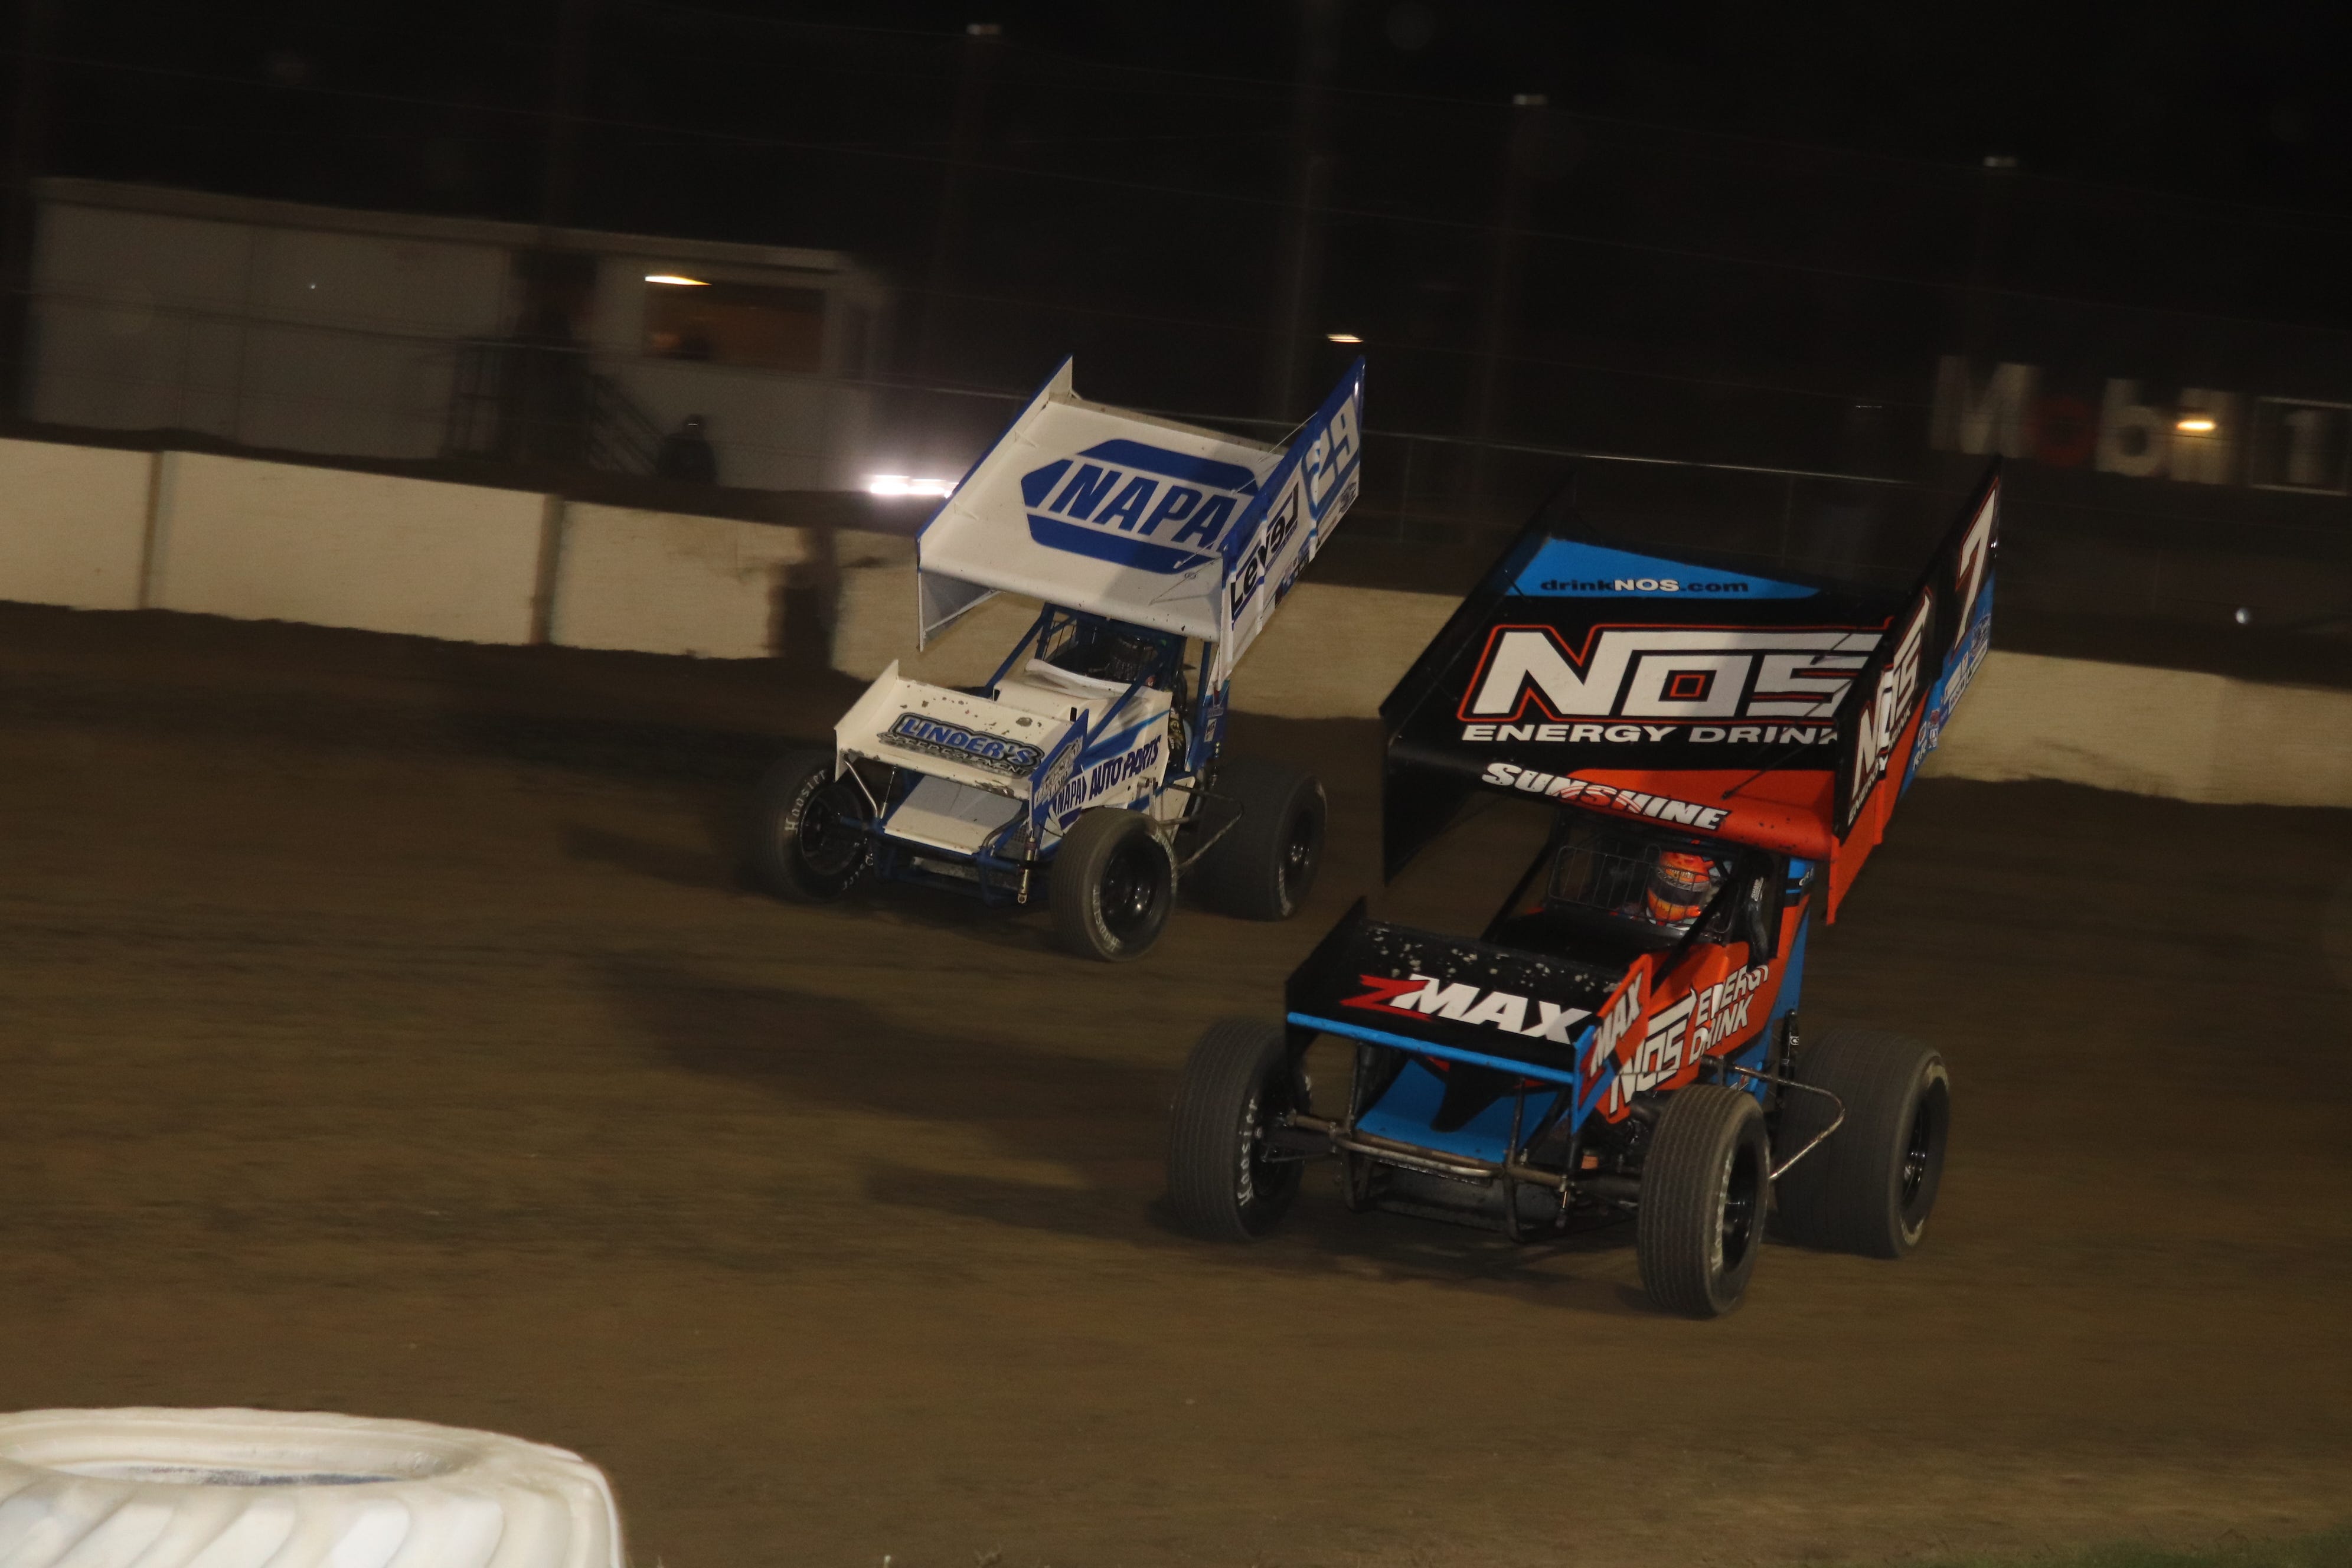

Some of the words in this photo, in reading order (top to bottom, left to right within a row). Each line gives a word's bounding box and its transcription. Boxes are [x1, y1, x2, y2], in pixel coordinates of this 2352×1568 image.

[1305, 394, 1359, 509] 29
[1054, 464, 1237, 551] NAPA
[1541, 579, 1749, 592] drinkNOS.com
[1952, 486, 1996, 655] 7
[1470, 628, 1884, 718] NOS
[900, 718, 1036, 766] LINDER'S
[1461, 724, 1678, 743] ENERGY
[1089, 756, 1123, 801] AUTO
[1482, 762, 1725, 831] SUNSHINE
[1609, 988, 1697, 1115] NOS
[1689, 994, 1755, 1066] DRINK
